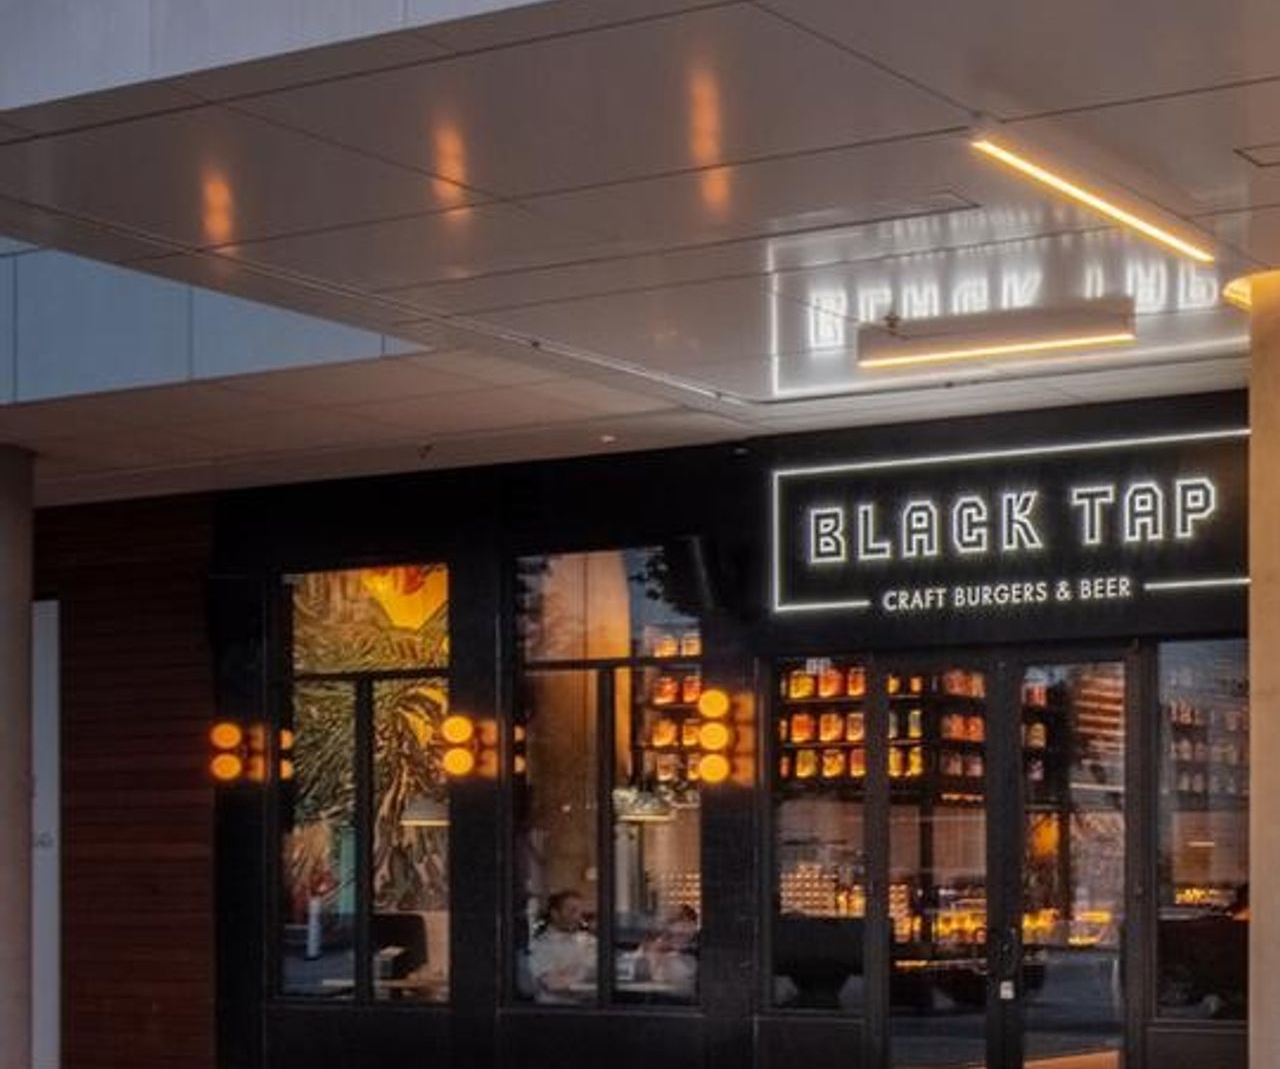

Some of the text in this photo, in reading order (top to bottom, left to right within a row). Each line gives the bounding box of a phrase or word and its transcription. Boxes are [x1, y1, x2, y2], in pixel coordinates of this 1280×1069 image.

[810, 477, 1217, 564] BLACK TAP
[883, 577, 1132, 611] CRAFT BURGERS & BEER
